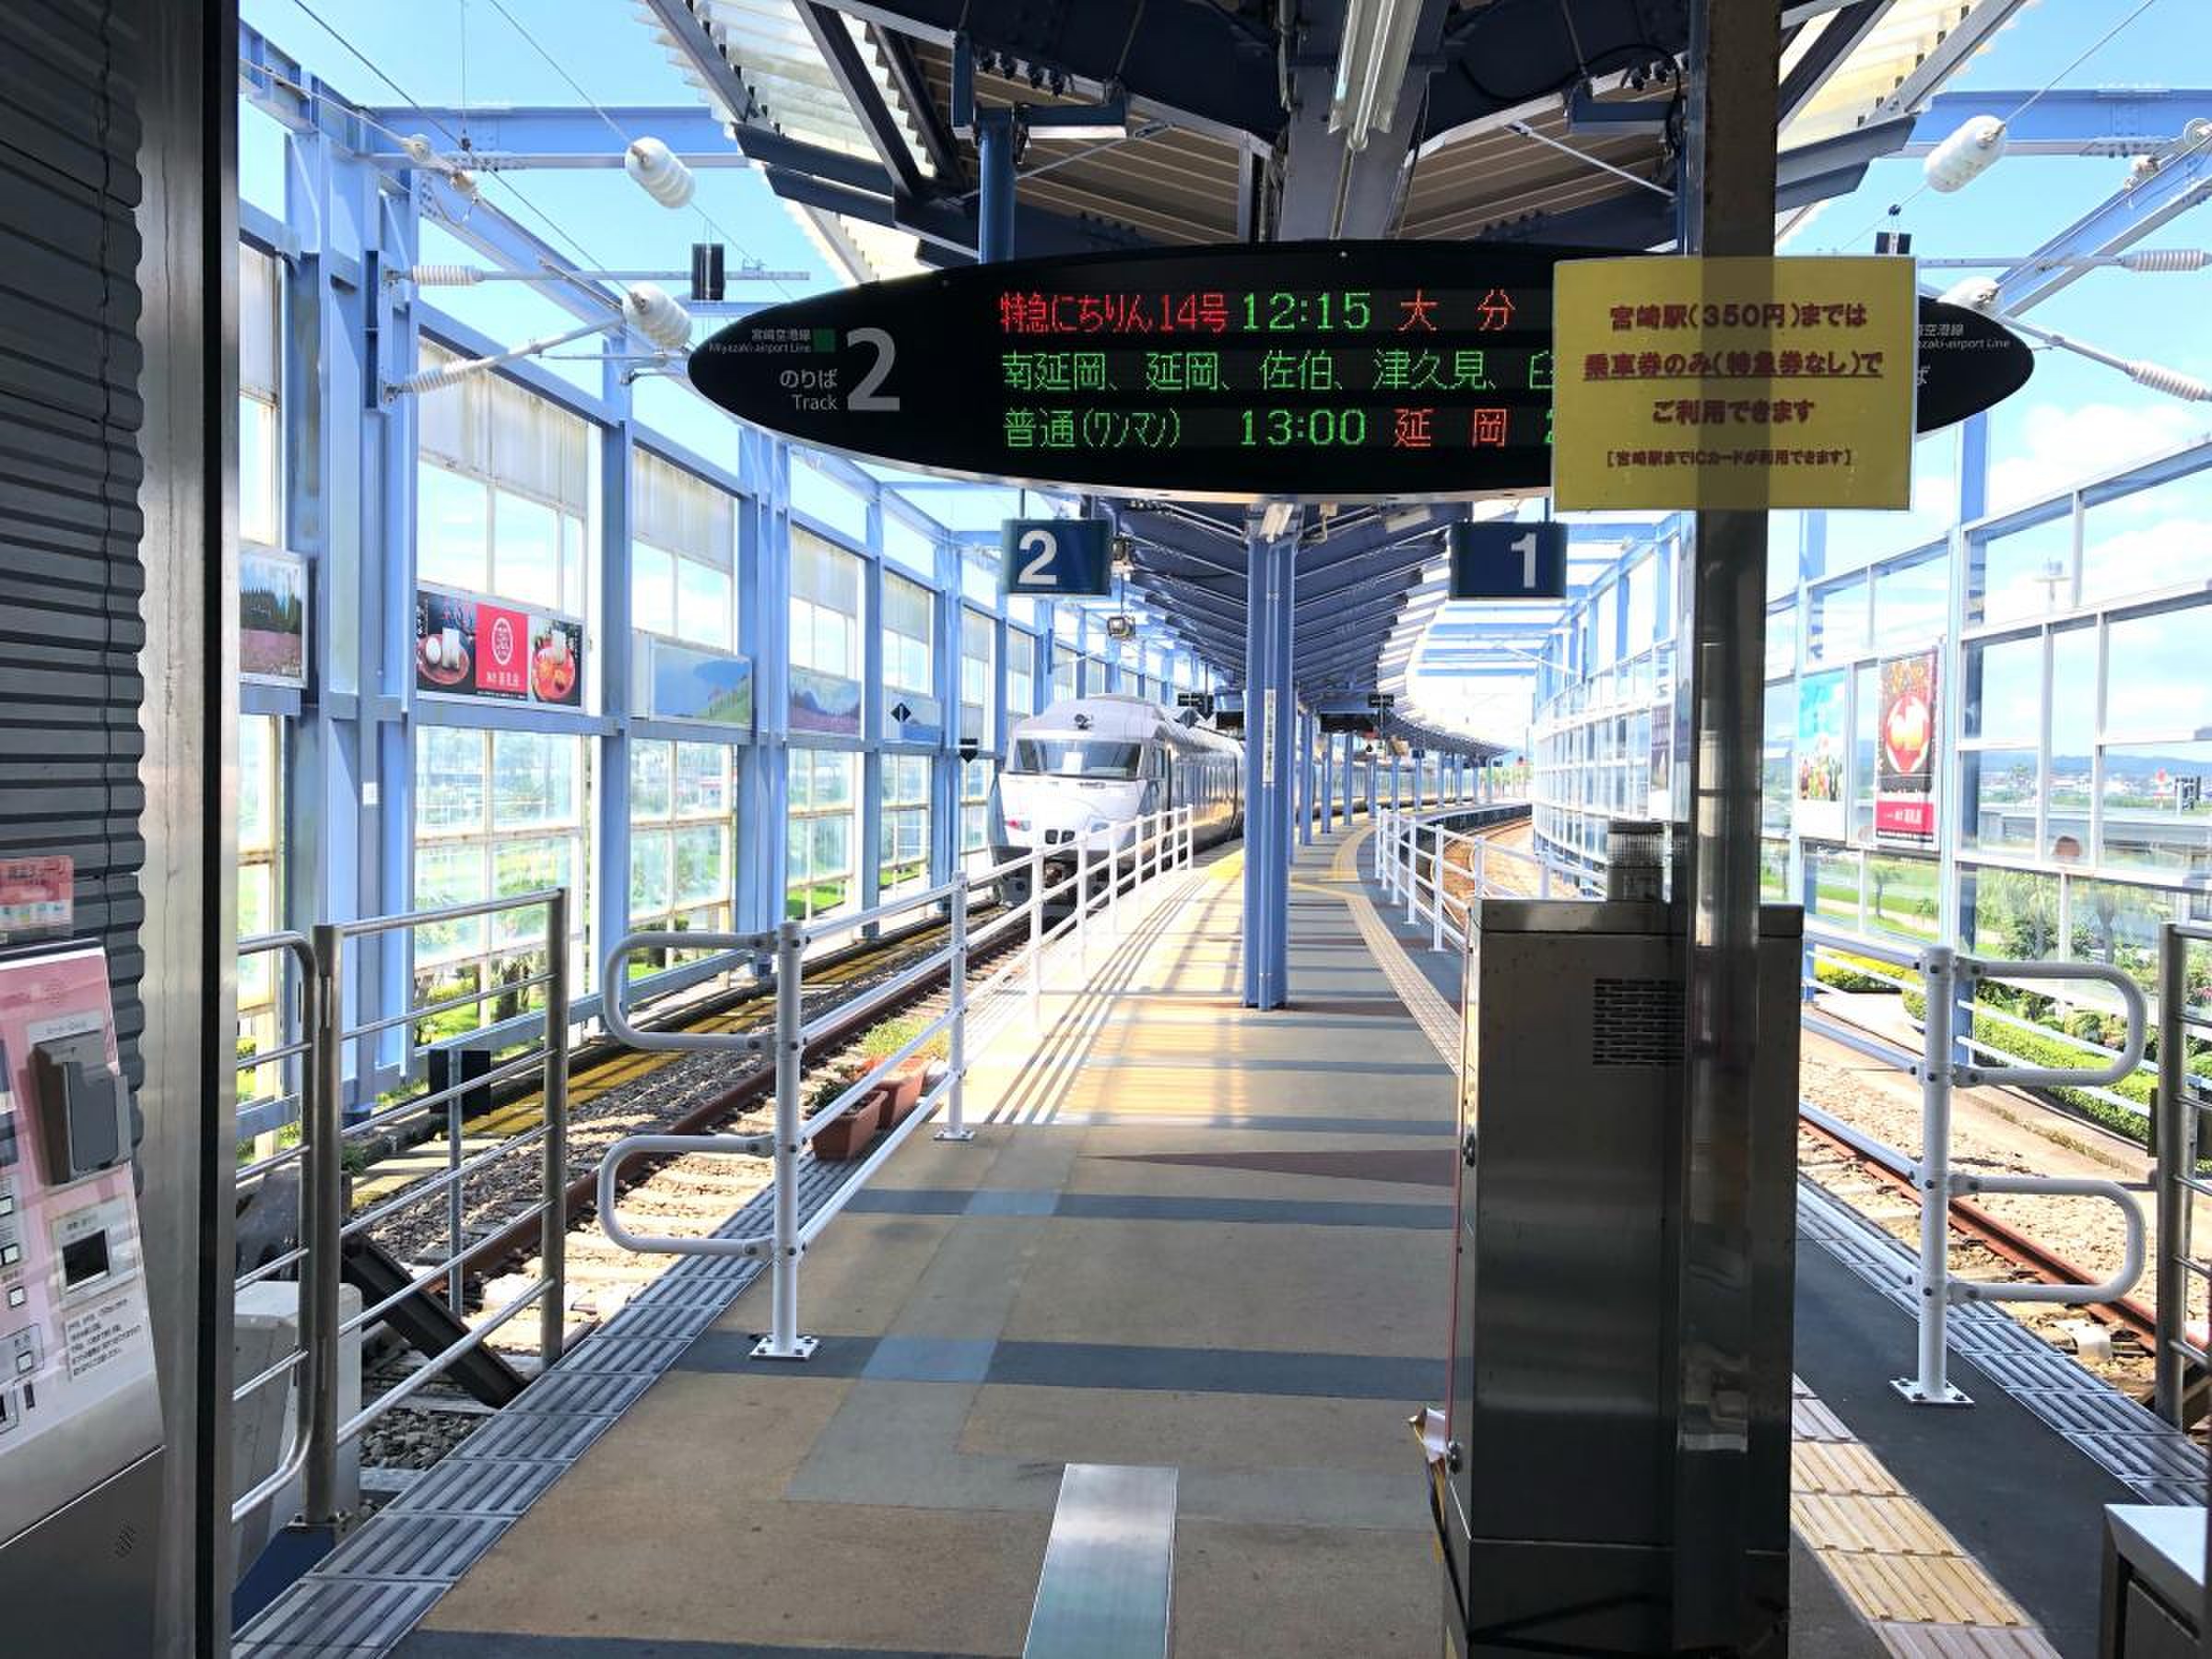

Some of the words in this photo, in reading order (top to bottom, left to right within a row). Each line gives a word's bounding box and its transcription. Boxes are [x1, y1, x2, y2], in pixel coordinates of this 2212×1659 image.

[1243, 292, 1371, 330] 12:15
[790, 343, 812, 353] Line
[780, 369, 839, 389] のりば
[846, 327, 900, 411] 2
[792, 394, 839, 411] Track
[1653, 398, 1816, 425] ご利用できます
[1241, 409, 1366, 446] 13:00
[1018, 530, 1058, 586] 2
[1510, 532, 1537, 589] 1
